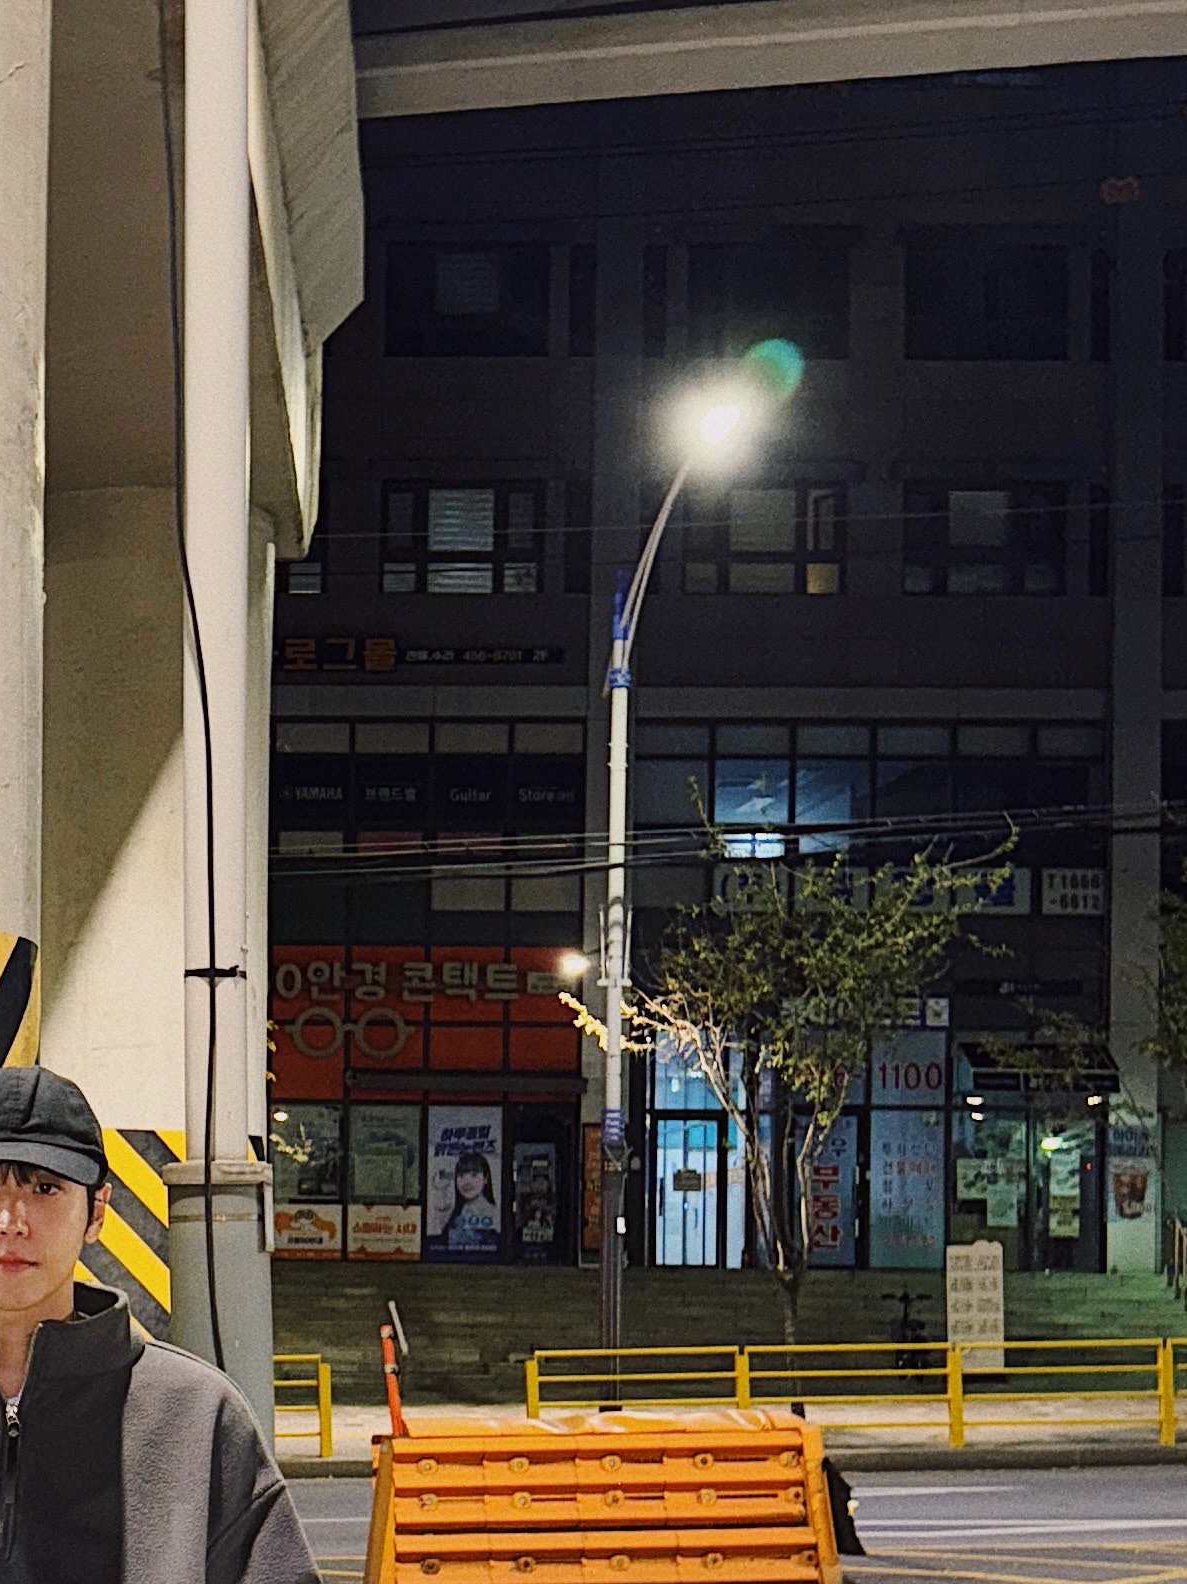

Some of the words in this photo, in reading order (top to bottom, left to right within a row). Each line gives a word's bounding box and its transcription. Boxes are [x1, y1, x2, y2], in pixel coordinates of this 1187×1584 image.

[295, 786, 343, 800] YAMAHA
[450, 788, 492, 802] Guitar
[402, 961, 520, 1002] 콘택트
[811, 1165, 841, 1249] 부동산
